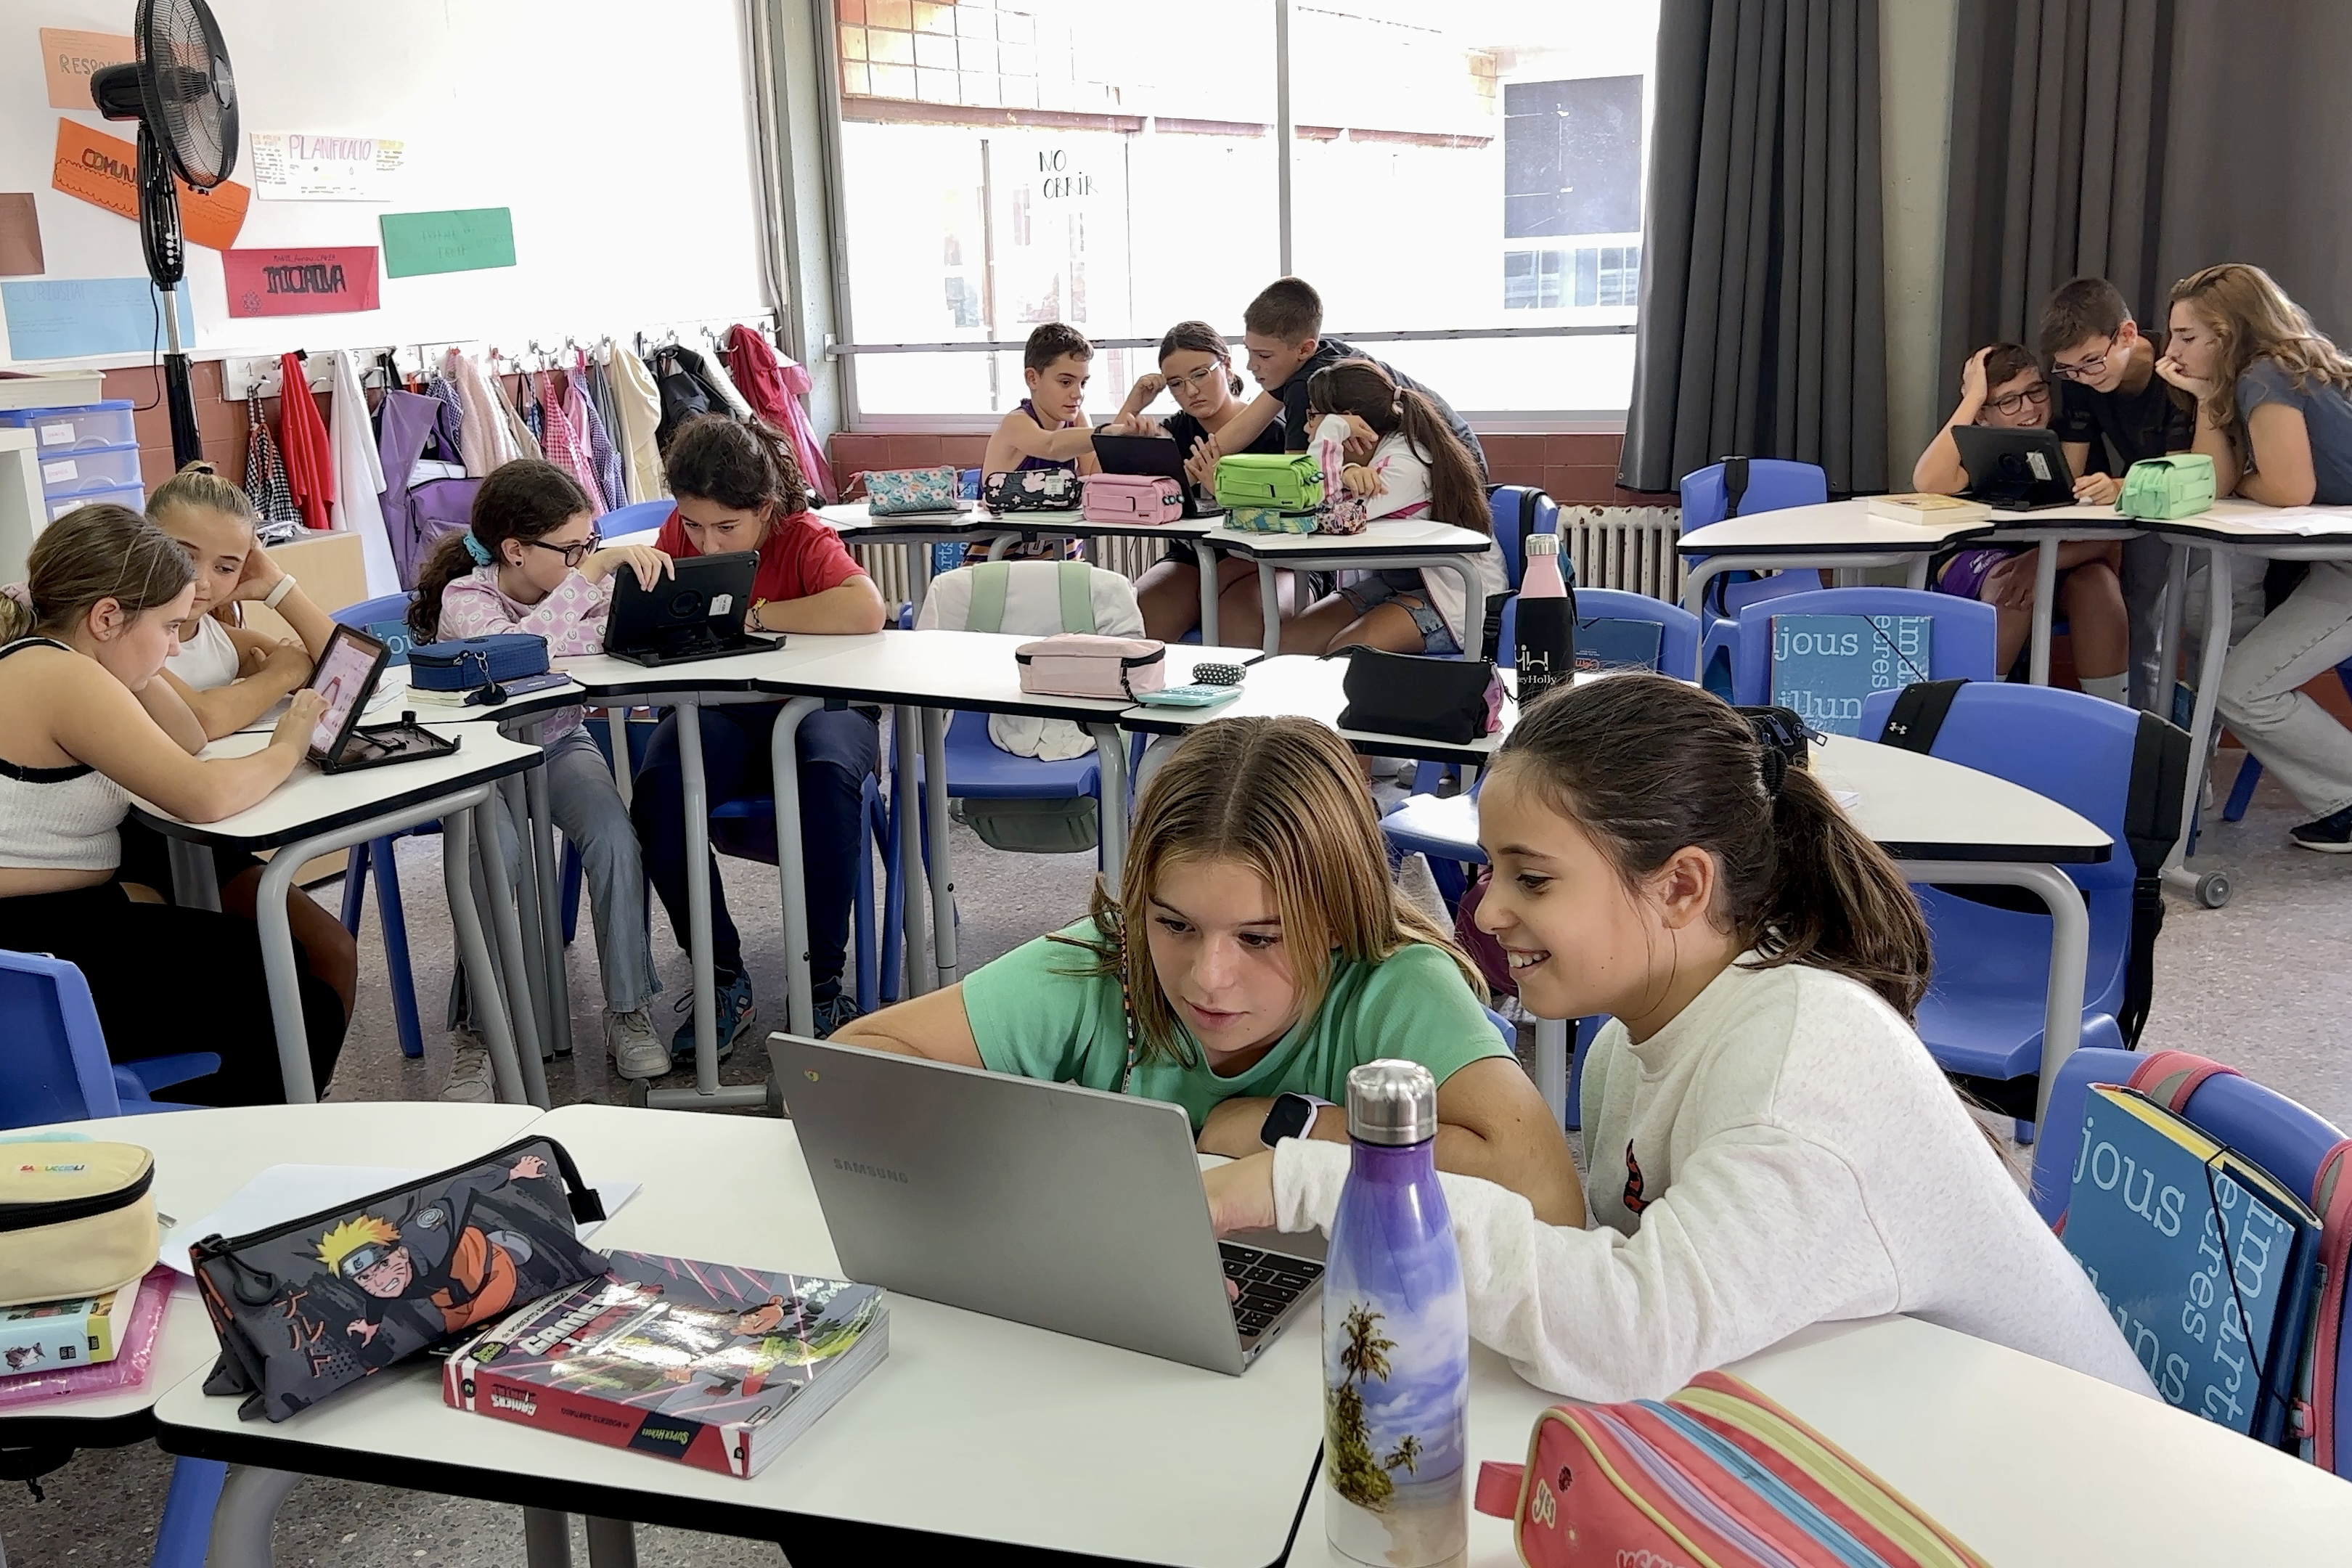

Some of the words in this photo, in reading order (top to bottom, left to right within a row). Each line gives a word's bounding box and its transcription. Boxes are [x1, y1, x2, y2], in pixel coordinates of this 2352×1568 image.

[59, 53, 121, 75] RESPO
[1039, 150, 1066, 172] NO
[833, 1158, 909, 1183] SAMSUNG
[509, 1311, 538, 1334] ROBERTO
[538, 1291, 569, 1313] SANTIAGO
